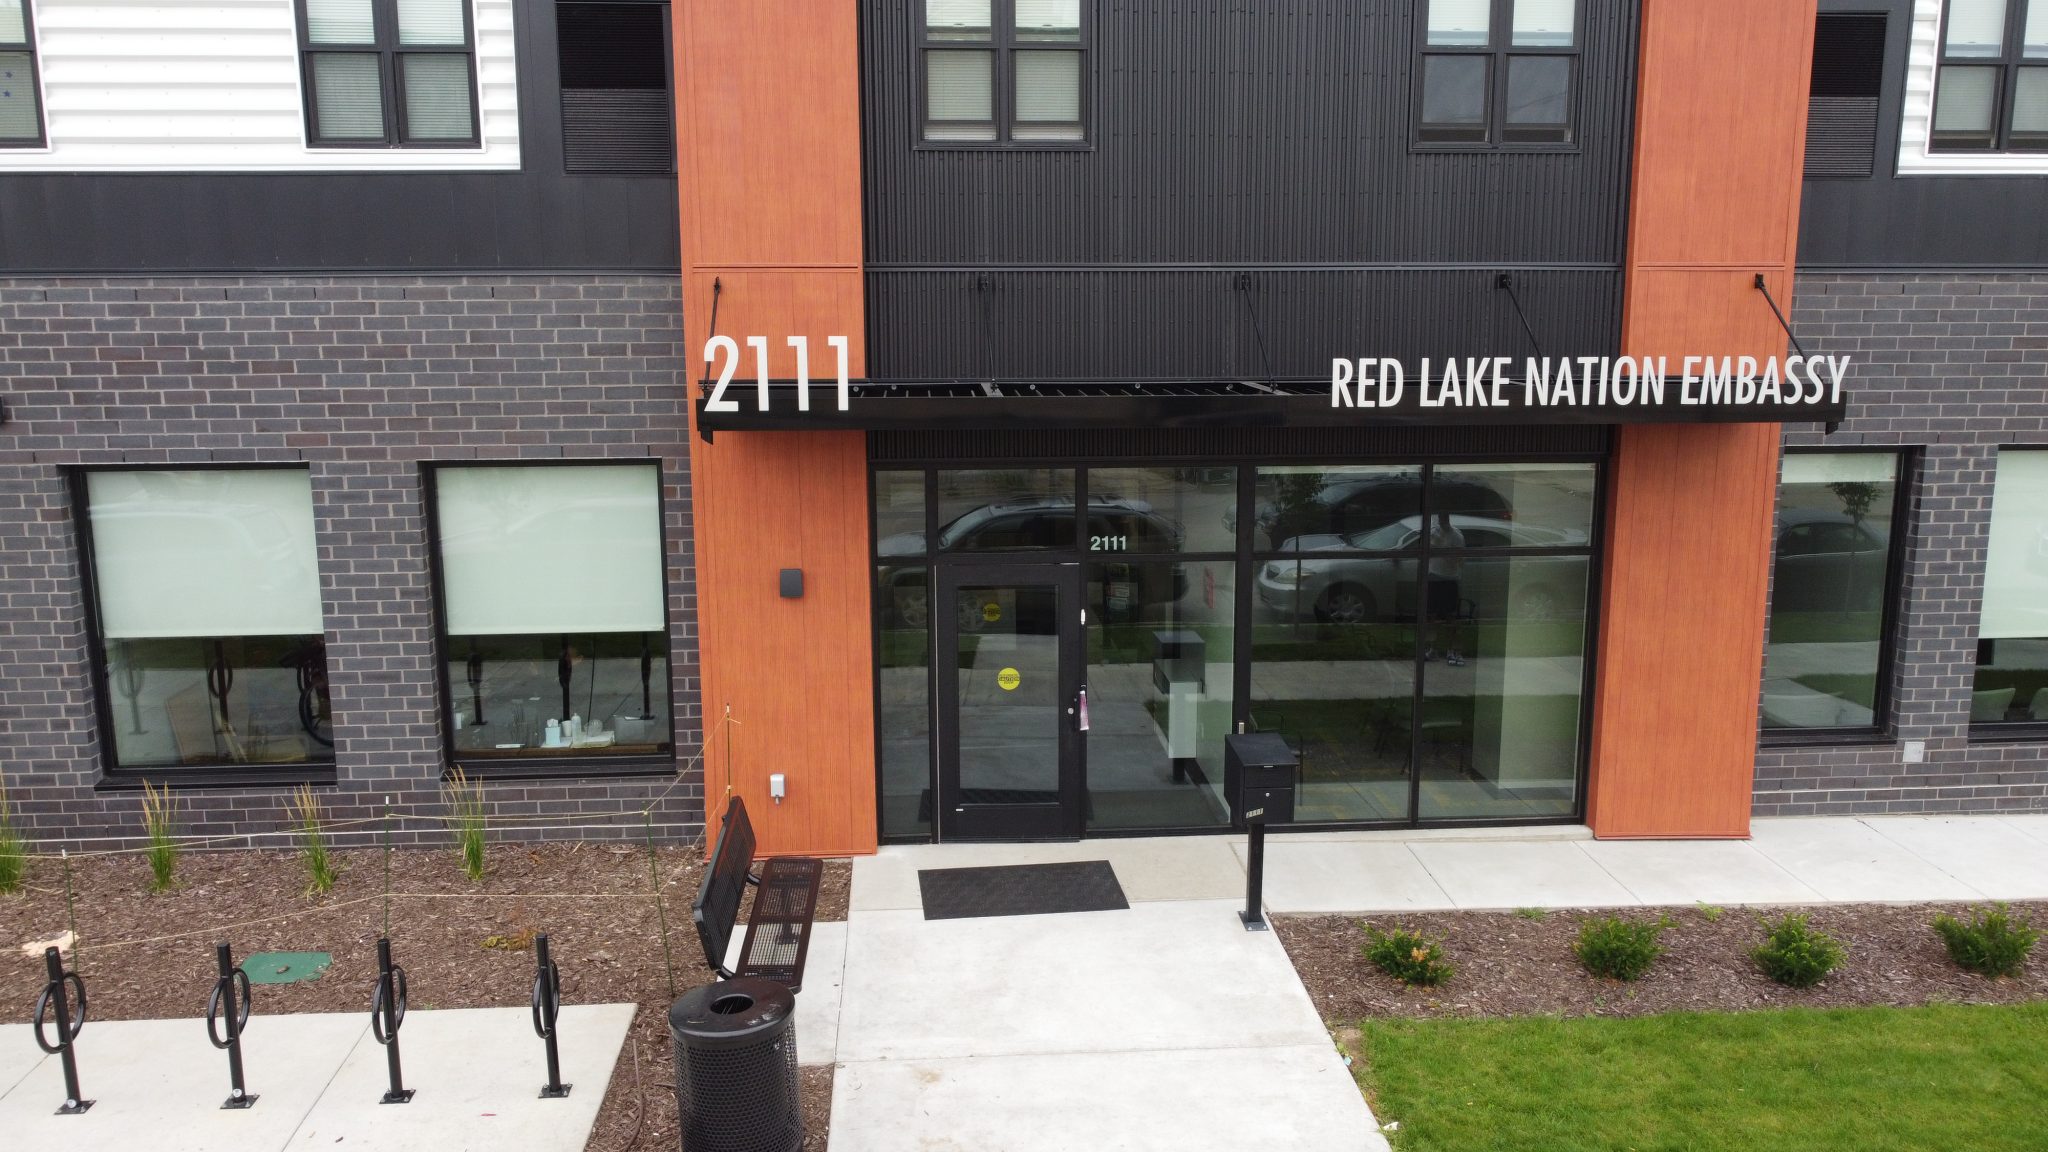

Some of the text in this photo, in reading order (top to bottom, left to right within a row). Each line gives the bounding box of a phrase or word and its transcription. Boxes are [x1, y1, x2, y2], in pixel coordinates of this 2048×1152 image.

[703, 335, 849, 412] 2111
[1331, 354, 1851, 408] RED LAKE NATION EMBASSY
[1090, 535, 1127, 551] 2111
